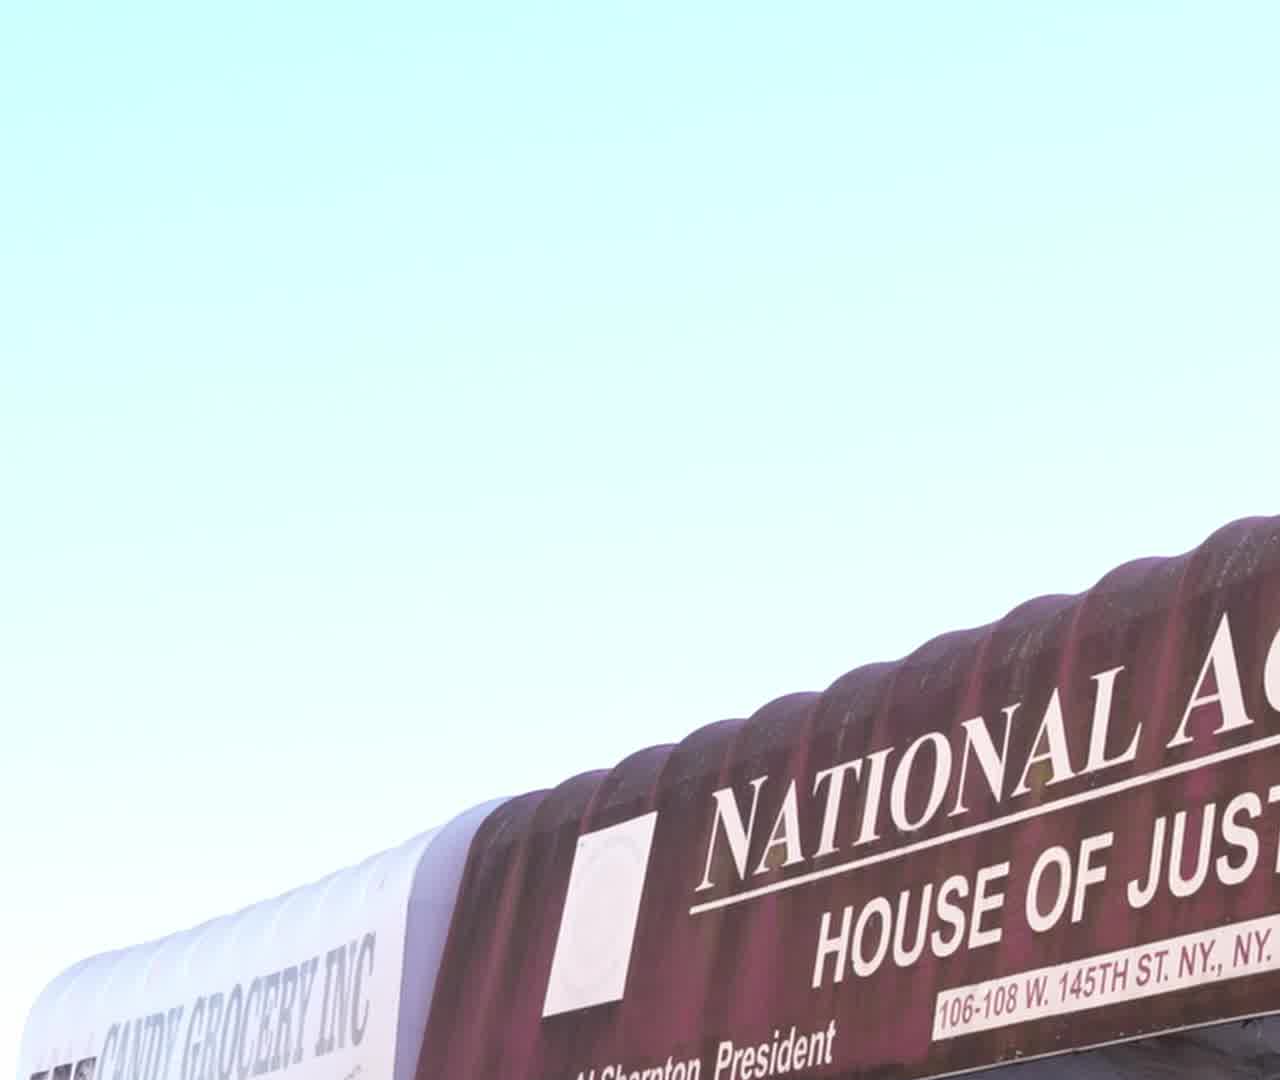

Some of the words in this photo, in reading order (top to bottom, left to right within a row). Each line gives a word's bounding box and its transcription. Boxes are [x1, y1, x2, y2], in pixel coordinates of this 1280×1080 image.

[695, 666, 1145, 893] NATIONAL
[812, 863, 1009, 987] HOUSE
[1026, 833, 1112, 932] OF
[938, 986, 1018, 1031] 106-108
[1026, 977, 1049, 1009] W.
[1058, 960, 1128, 1002] 145TH
[1135, 950, 1170, 982] ST.
[1233, 927, 1272, 968] NY.
[315, 930, 376, 1056] INC
